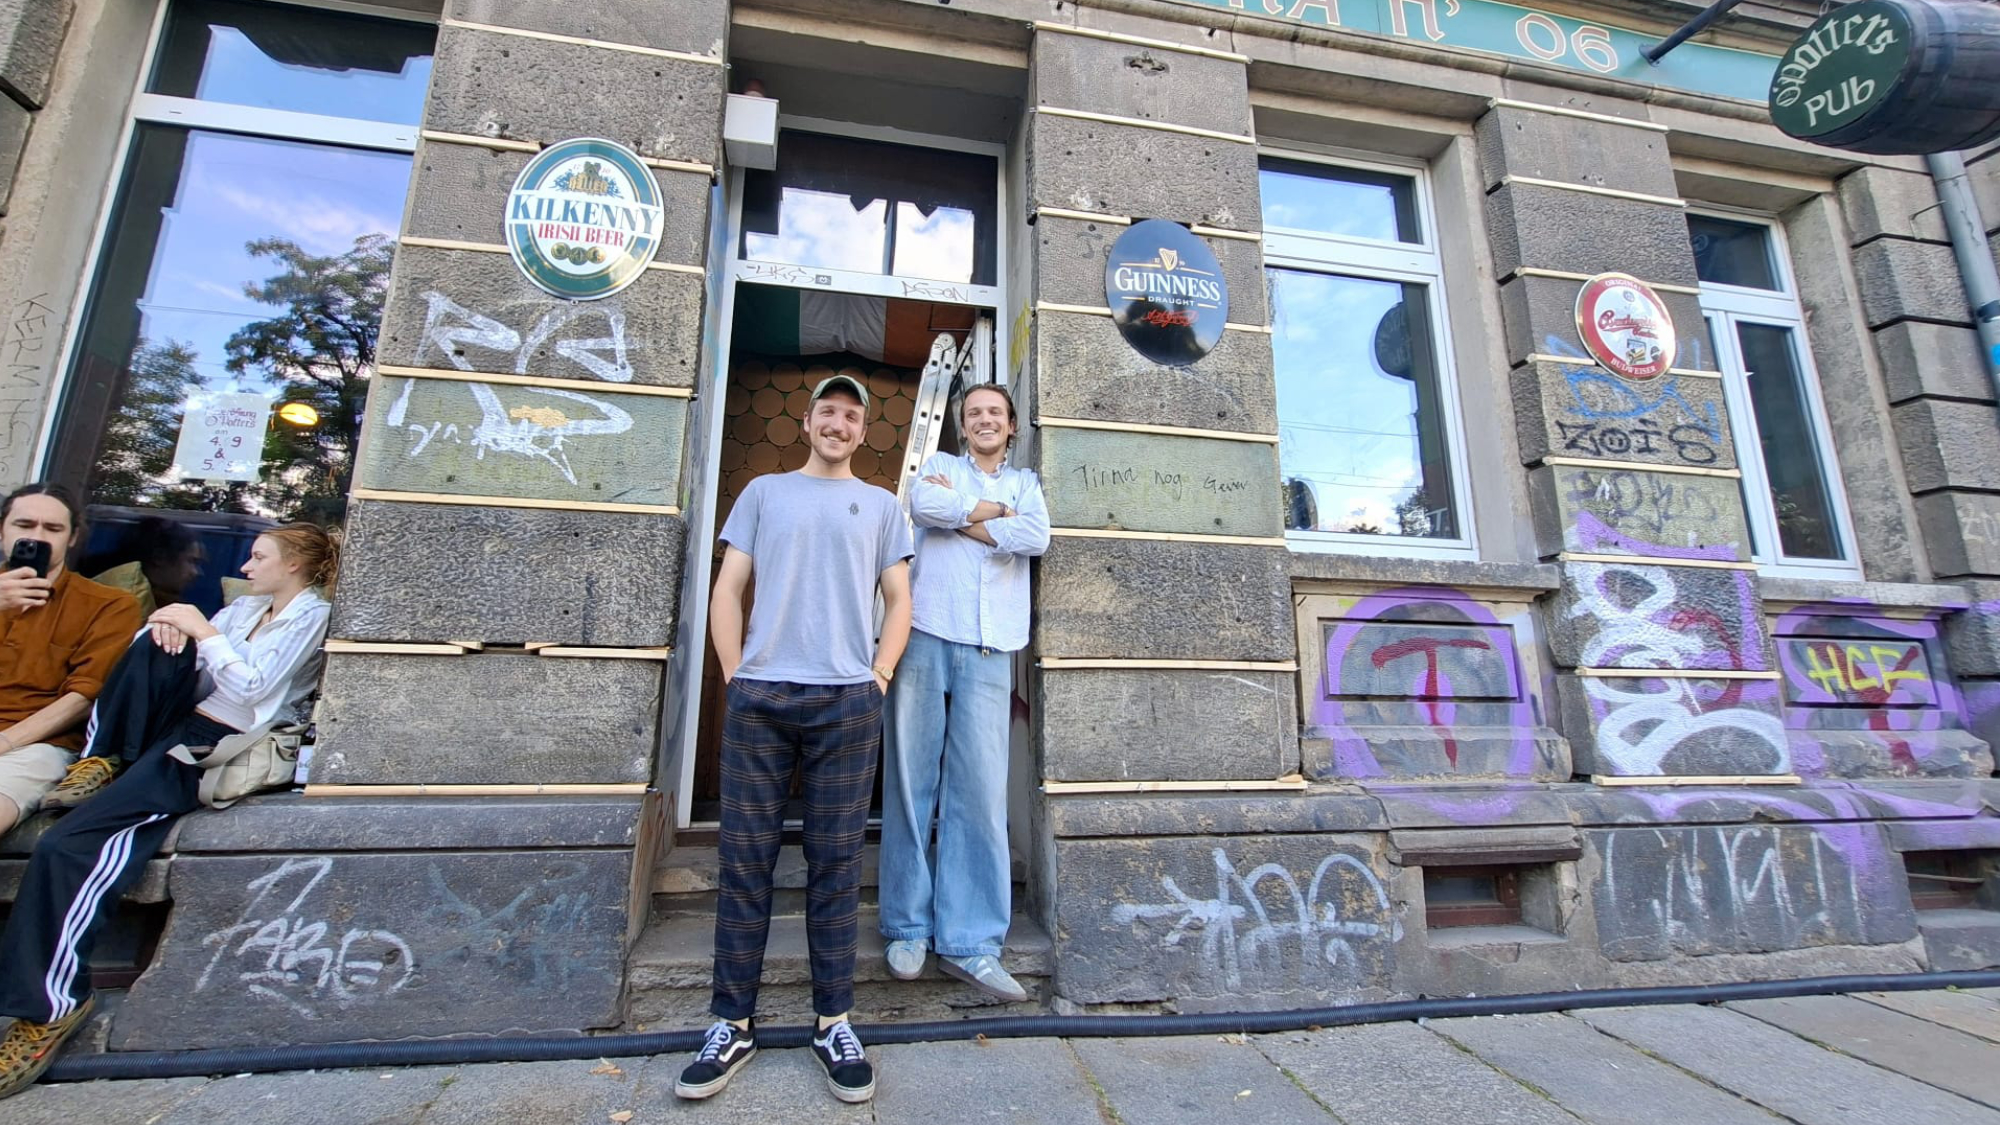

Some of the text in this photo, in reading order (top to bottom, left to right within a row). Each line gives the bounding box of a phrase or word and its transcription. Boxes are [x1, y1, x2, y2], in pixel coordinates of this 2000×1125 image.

[511, 193, 661, 236] KILKENNY
[538, 222, 625, 248] IRISH BEER
[1114, 266, 1222, 302] GUINNESS
[1147, 295, 1195, 307] DRAUGHT
[1610, 357, 1657, 375] BUDWEISER
[214, 447, 225, 459] &
